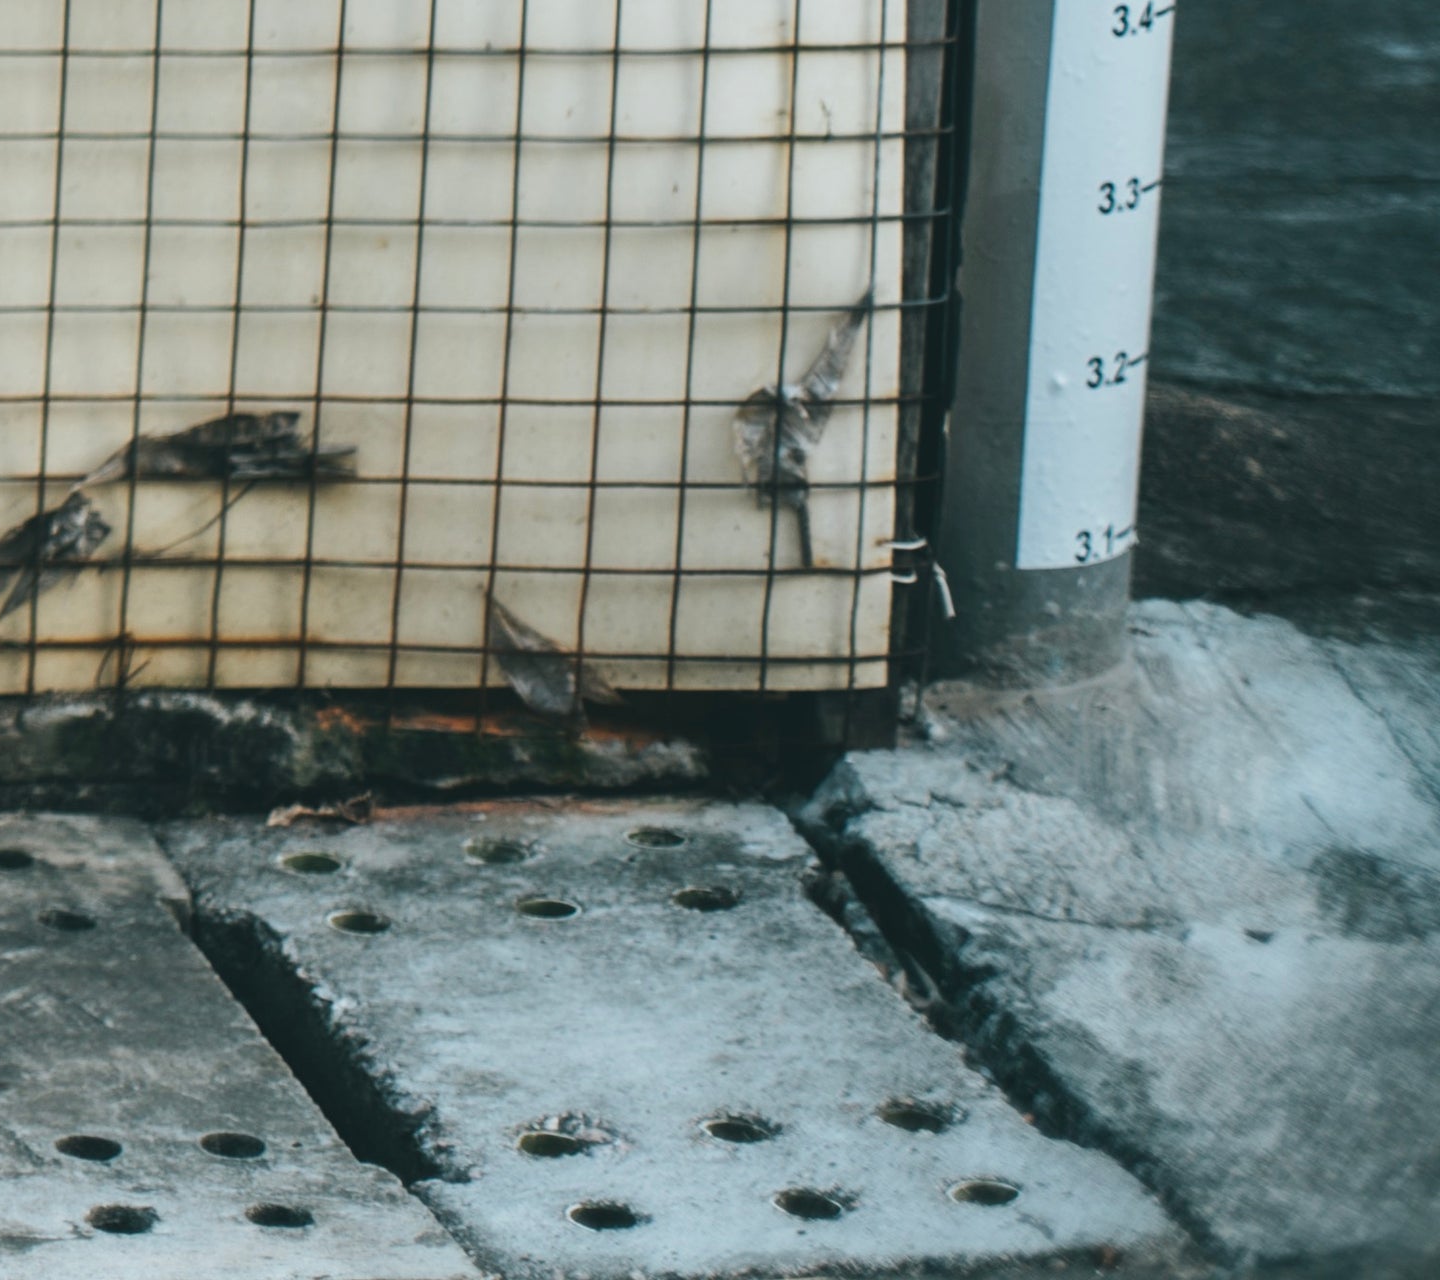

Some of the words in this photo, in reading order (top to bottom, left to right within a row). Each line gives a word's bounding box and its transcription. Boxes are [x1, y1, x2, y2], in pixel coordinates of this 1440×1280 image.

[1111, 0, 1154, 38] 3.4
[1097, 177, 1141, 215] 3.3
[1085, 350, 1128, 390] 3.2
[1074, 524, 1114, 563] 3.1
